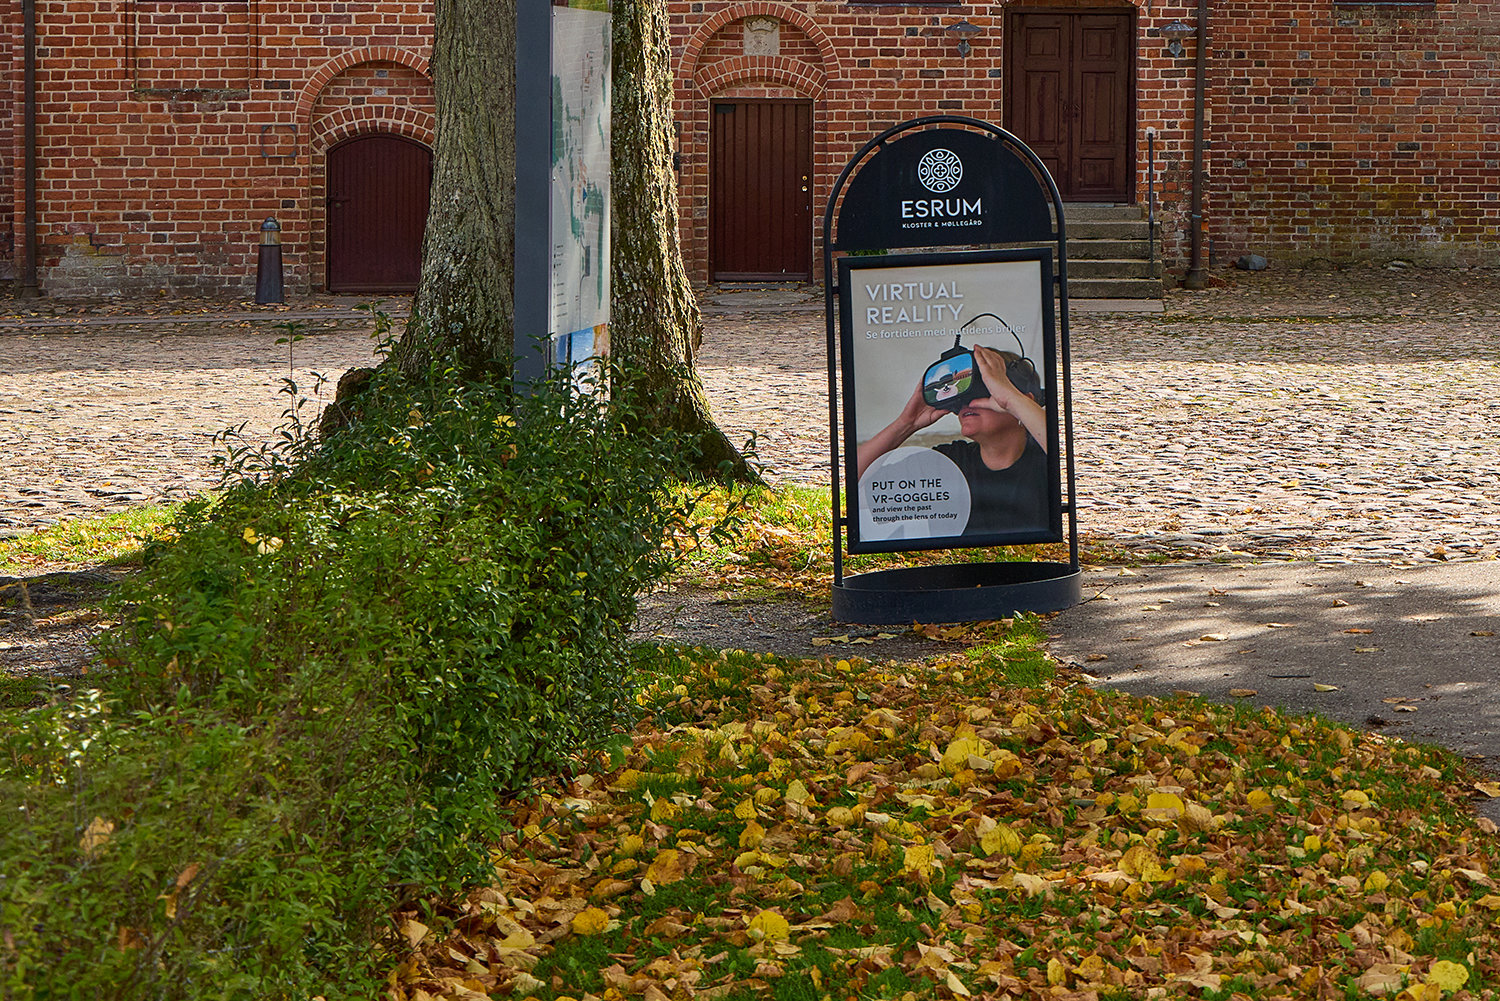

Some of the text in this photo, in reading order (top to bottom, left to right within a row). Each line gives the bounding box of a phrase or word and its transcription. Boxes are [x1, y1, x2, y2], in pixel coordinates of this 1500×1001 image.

[901, 198, 982, 218] ESRUM
[941, 219, 983, 227] MØLLEGÅRD
[865, 281, 964, 301] VIRTUAL
[866, 303, 964, 325] REALITY
[866, 330, 878, 340] Se
[880, 327, 922, 340] fortiden
[924, 325, 946, 337] med
[872, 478, 942, 490] PUT ON THE
[872, 491, 950, 503] VR-GOGGLES
[904, 504, 915, 512] the
[917, 504, 932, 513] past
[938, 512, 958, 520] today
